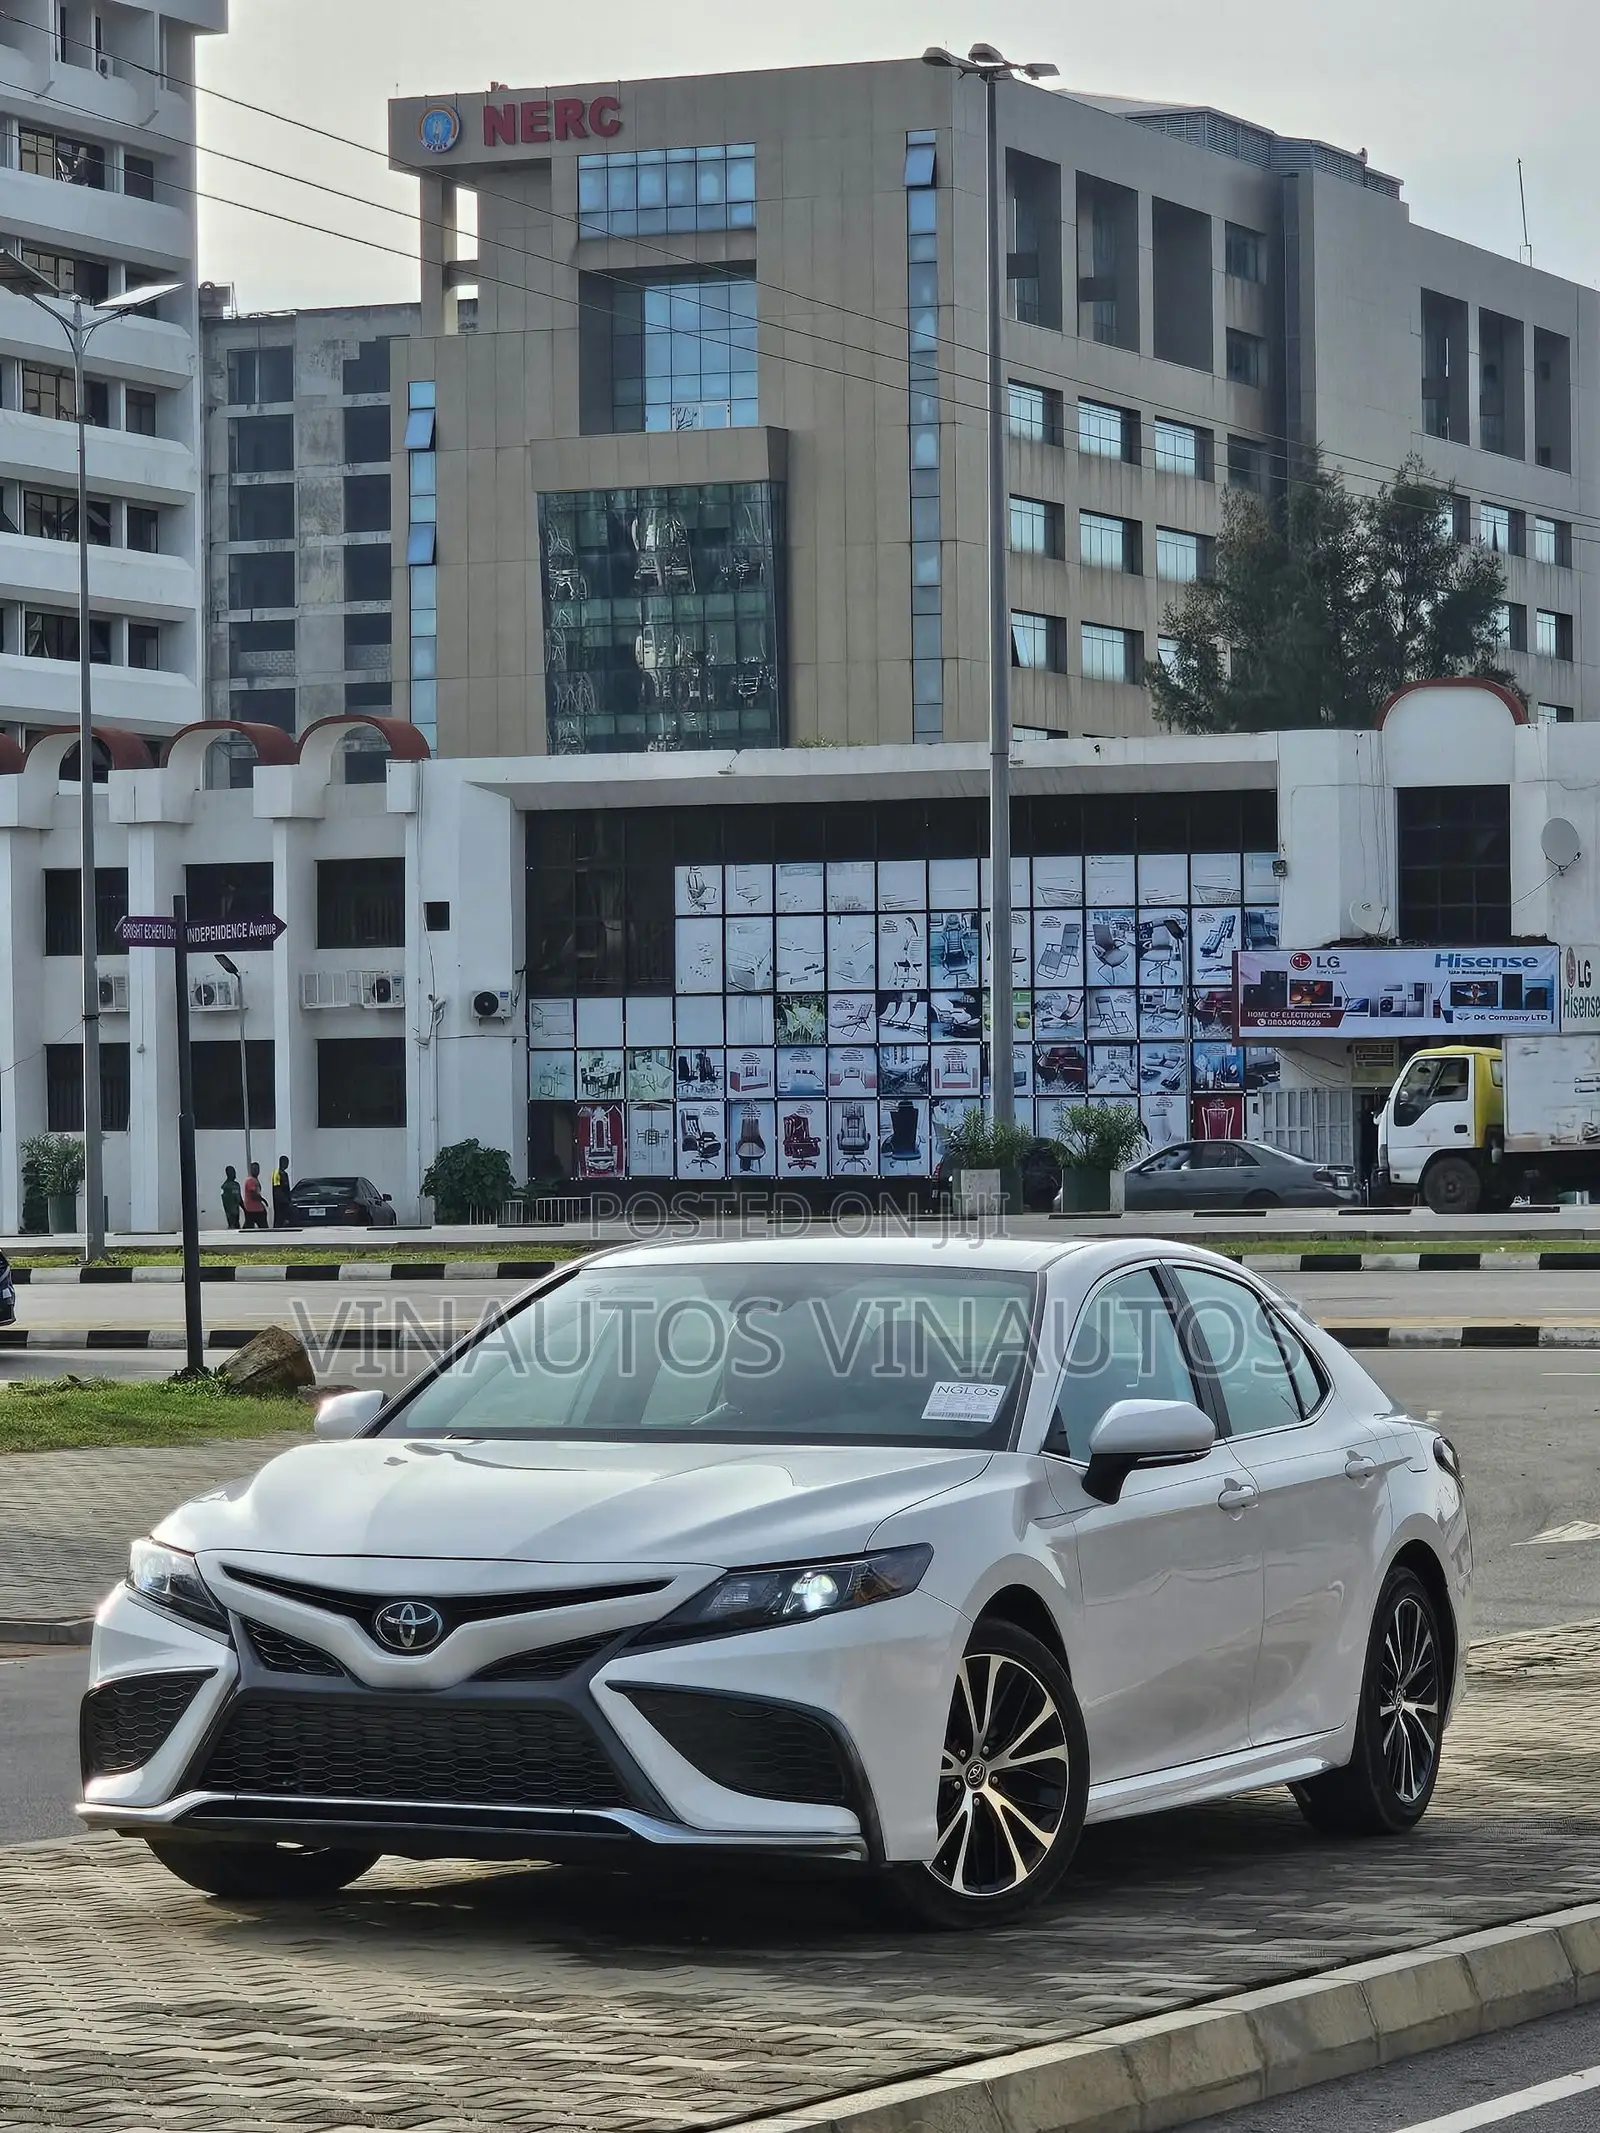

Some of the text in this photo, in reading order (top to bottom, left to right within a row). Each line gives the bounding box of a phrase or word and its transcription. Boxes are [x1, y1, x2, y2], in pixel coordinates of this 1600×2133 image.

[483, 96, 622, 147] NERC
[123, 923, 144, 939] BRIGHT
[186, 922, 277, 943] INDEPENDENCE Avenue
[1316, 955, 1341, 969] LG
[1434, 953, 1539, 968] Hisense
[1577, 959, 1592, 989] LG
[1562, 988, 1600, 1019] Hisense
[1281, 1011, 1332, 1019] ELECTRONICS
[1488, 1014, 1530, 1022] Company
[936, 1385, 1000, 1397] NGLOS
